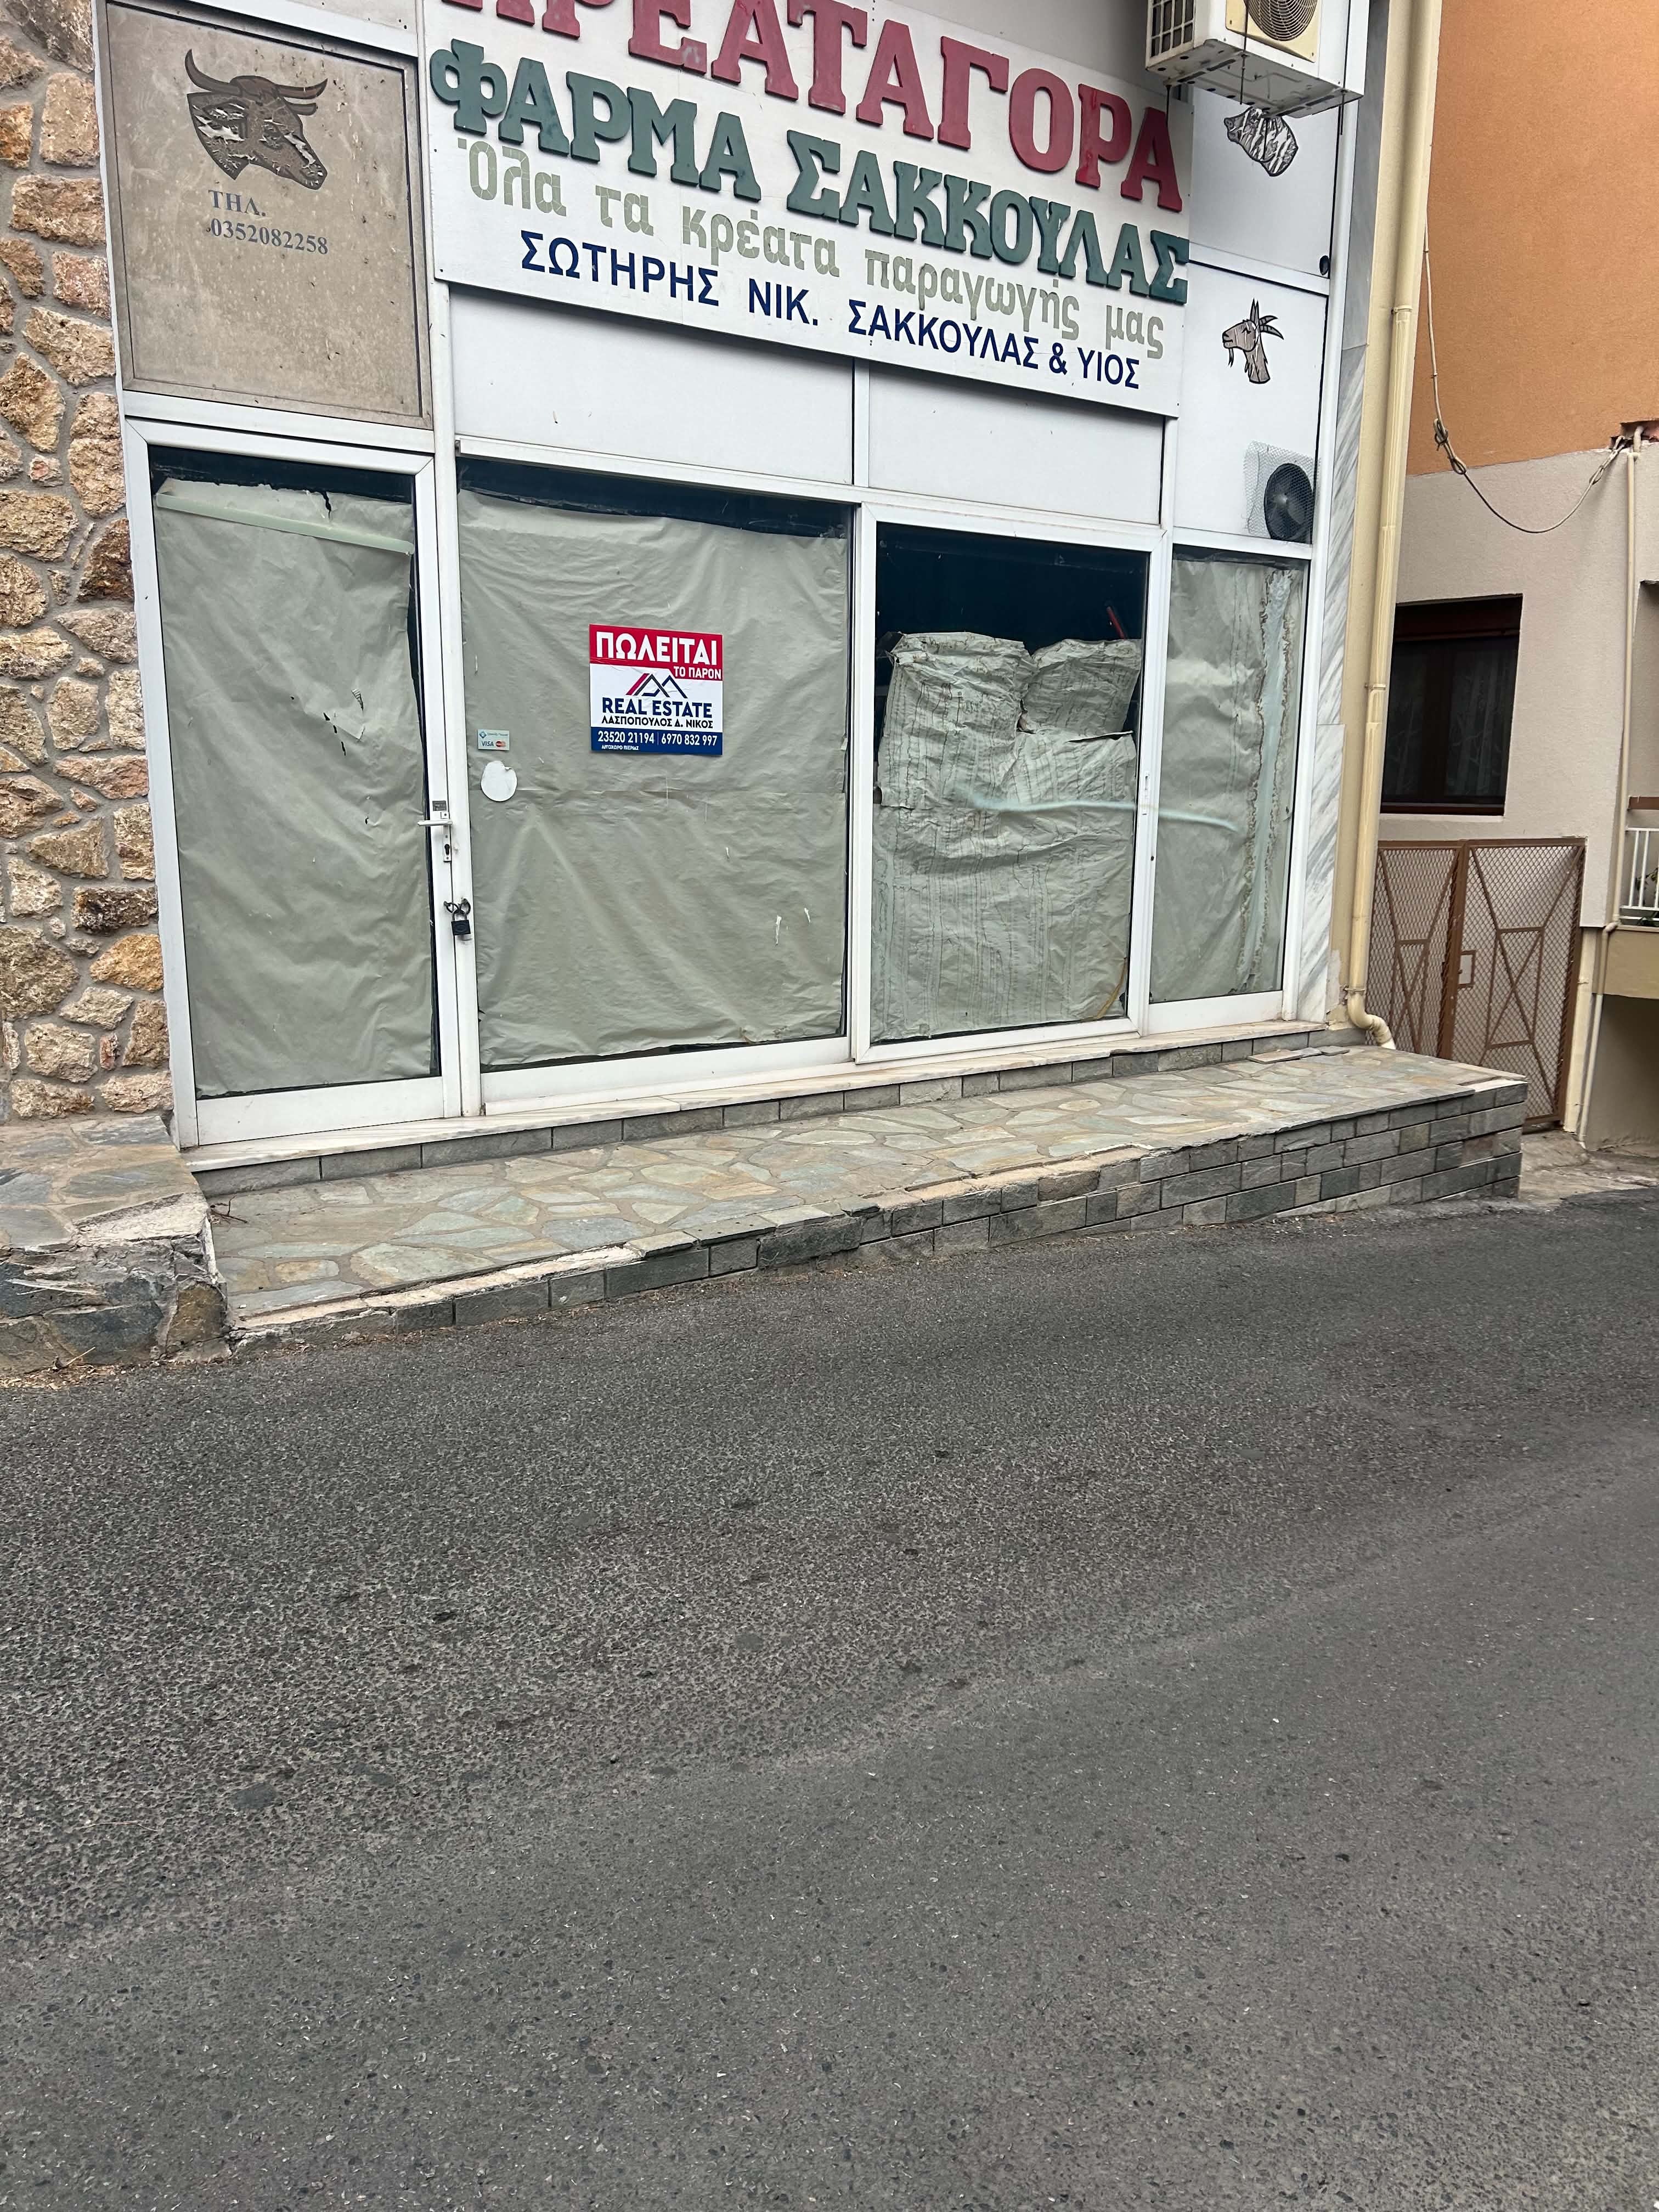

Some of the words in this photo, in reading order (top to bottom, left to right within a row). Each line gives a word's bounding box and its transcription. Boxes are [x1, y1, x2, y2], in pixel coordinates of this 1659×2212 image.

[442, 0, 1183, 212] ΕΑΤΑΓΟΡΑ
[430, 38, 761, 202] ΦΑΡΜΑ
[786, 129, 1190, 304] ΣΑΚΚΟΥΛΑΣ
[208, 189, 266, 217] ΤΗΛ.
[211, 218, 329, 255] 0352082258
[458, 137, 567, 217] Όλα
[595, 185, 653, 236] τα
[682, 205, 840, 278] κρέατα
[865, 249, 1079, 341] παραγωγής
[1105, 303, 1164, 359] μας
[521, 229, 720, 307] ΣΩΤΗΡΗΣ
[748, 278, 819, 326] ΝΙΚ.
[848, 298, 1040, 370] ΣΑΚΚΟΥΛΑΣ
[1049, 343, 1067, 375] &
[1077, 347, 1140, 390] ΥΙΟΣ
[596, 631, 717, 665] ΠΩΛΕΙΤΑΙ
[674, 665, 686, 677] ΤΟ
[689, 667, 721, 680] ΠΑΡΟΝ
[601, 715, 673, 727] ΛΑΣΠΟΠΟΥΛΟΣ
[674, 719, 684, 727] Δ.
[686, 719, 713, 729] ΝΙΚΟΣ
[602, 697, 647, 715] REAL
[652, 700, 712, 718] ESTATE
[598, 730, 625, 743] 23520
[628, 732, 654, 744] 21194
[661, 733, 682, 745] 6970
[684, 735, 700, 746] 832
[702, 735, 718, 746] 997
